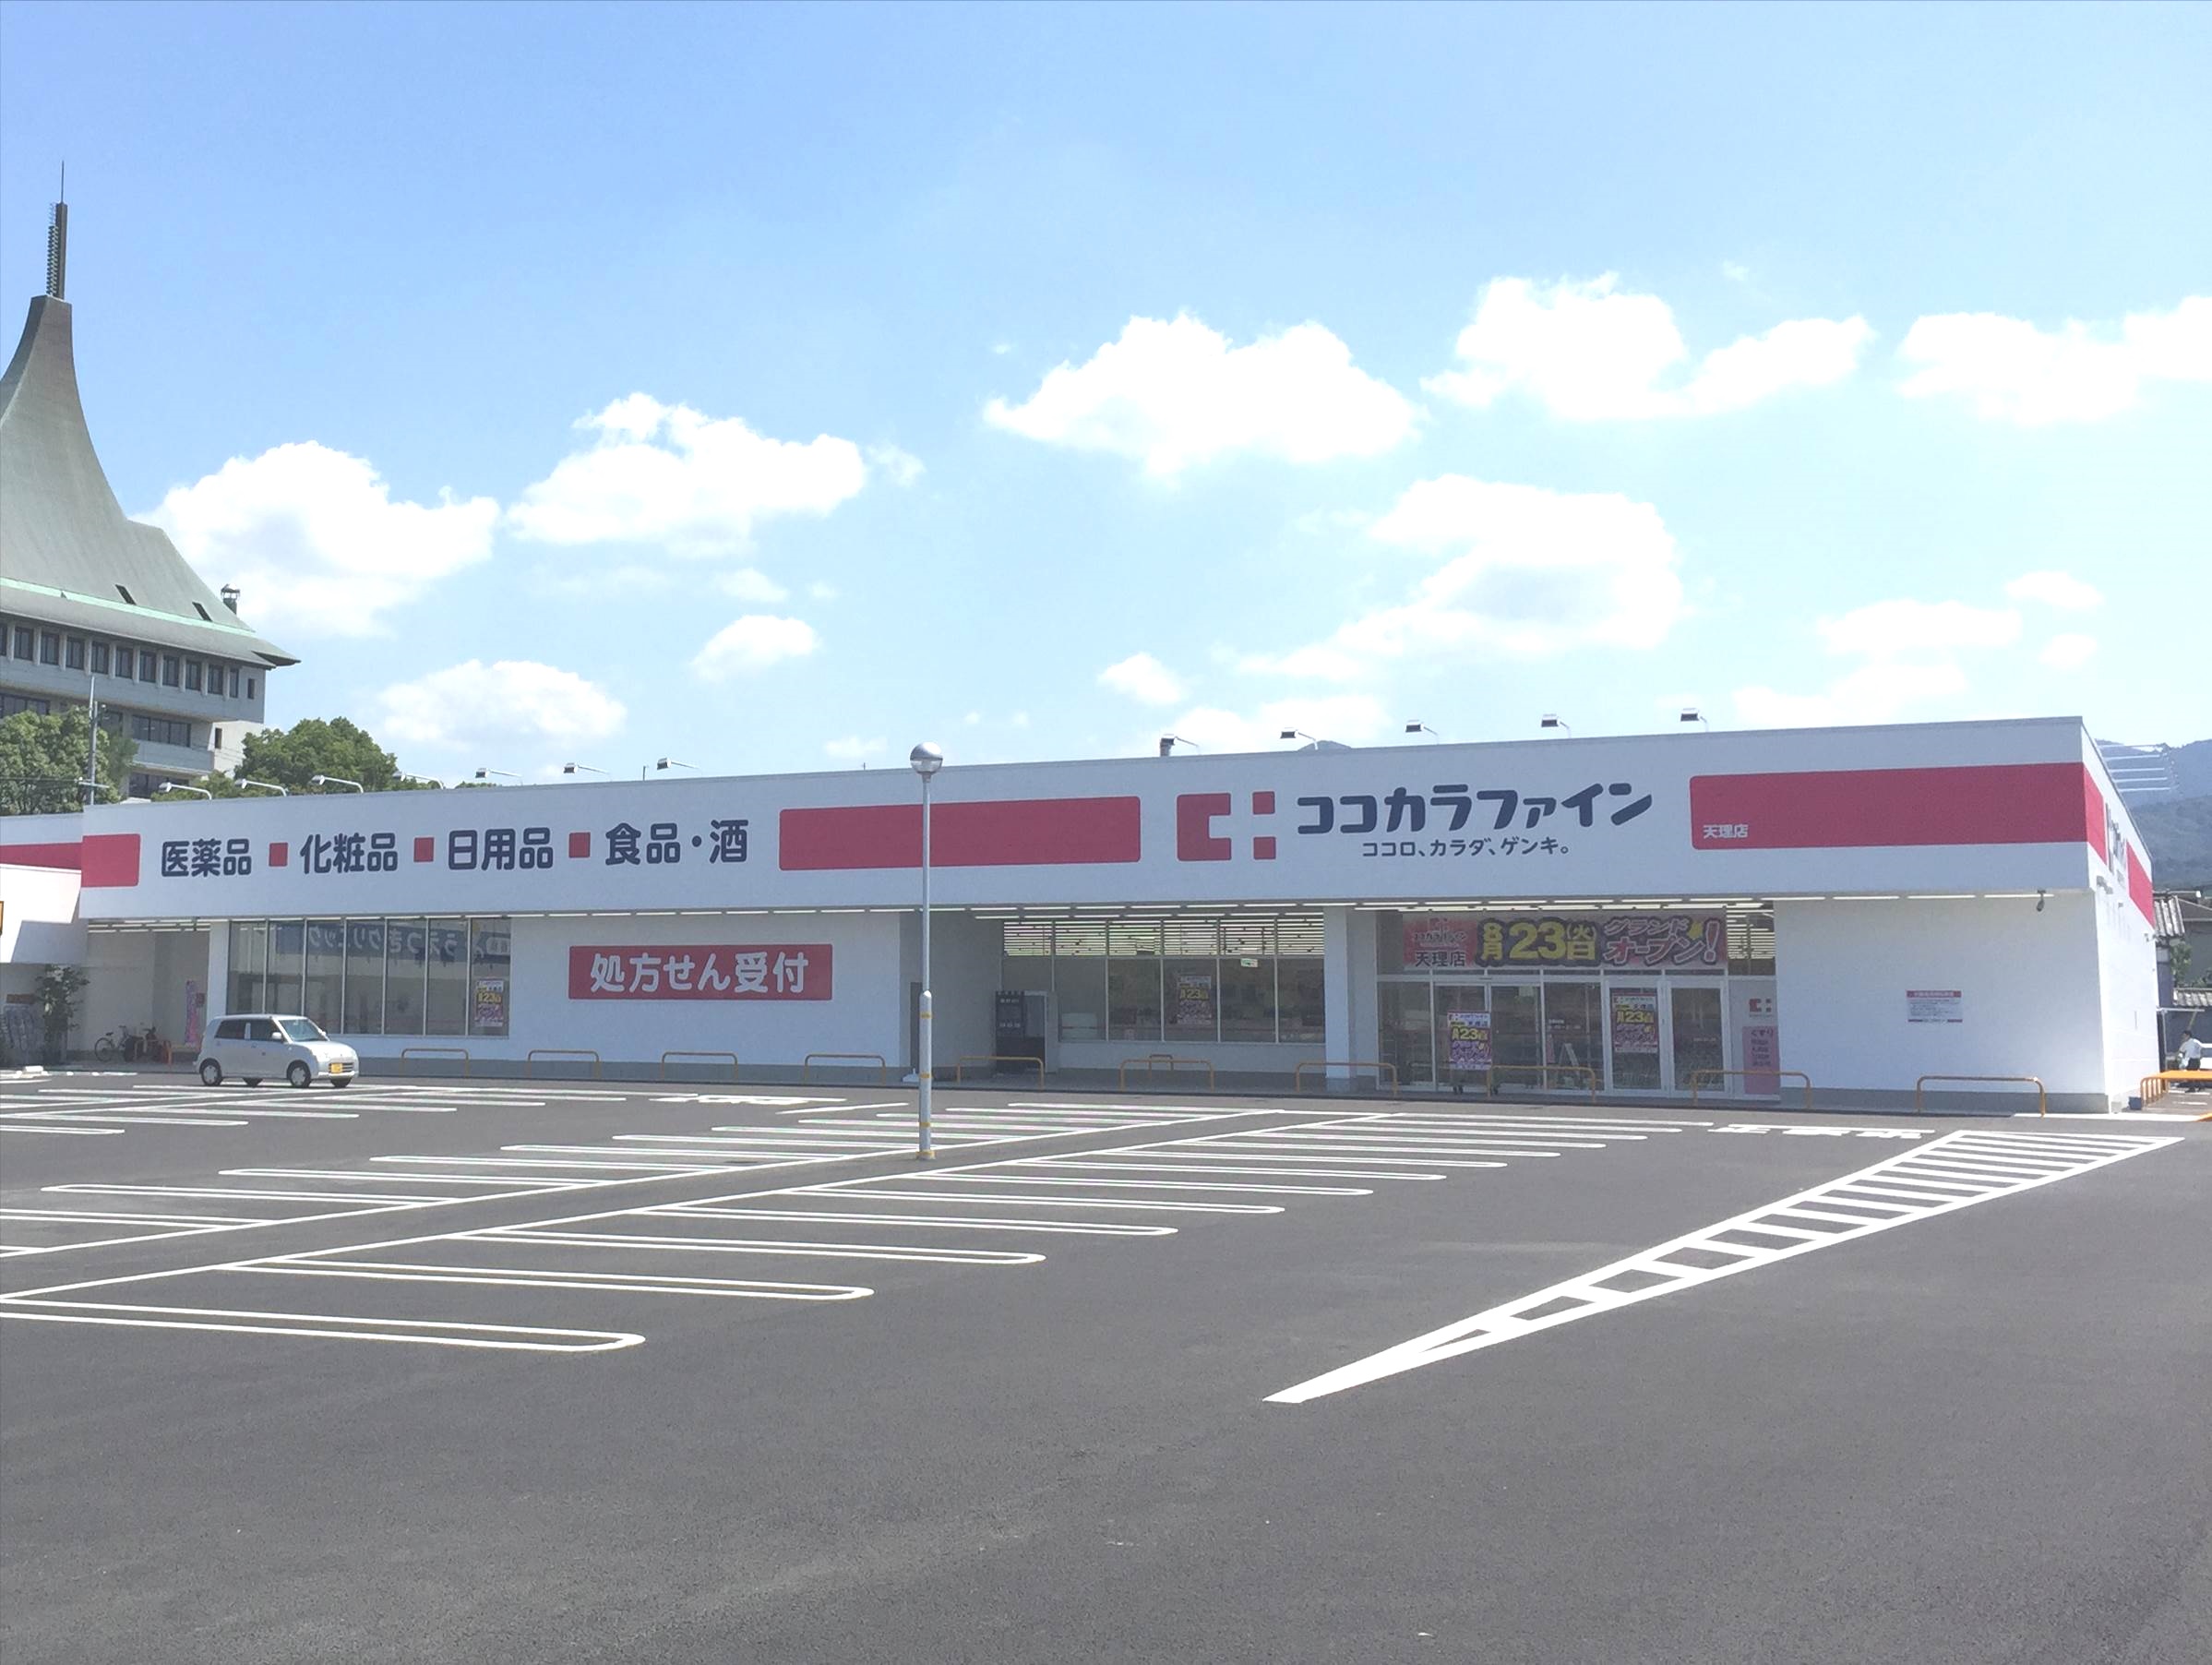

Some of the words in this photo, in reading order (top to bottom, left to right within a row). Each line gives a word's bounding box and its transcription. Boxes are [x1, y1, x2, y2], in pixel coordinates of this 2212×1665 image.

[1297, 783, 1653, 835] ココカラファイン
[1703, 824, 1749, 839] 天理店
[161, 838, 251, 878] 医薬品
[300, 832, 398, 875] 化粧品
[448, 828, 554, 871] 日用品
[605, 820, 749, 867] 食品・酒
[1362, 836, 1569, 857] ココロ、カラダ、ゲンキ。
[1509, 922, 1566, 960] 23
[1604, 918, 1688, 936] グランド
[591, 952, 808, 993] 処方せん受付
[1416, 951, 1465, 967] 天理店
